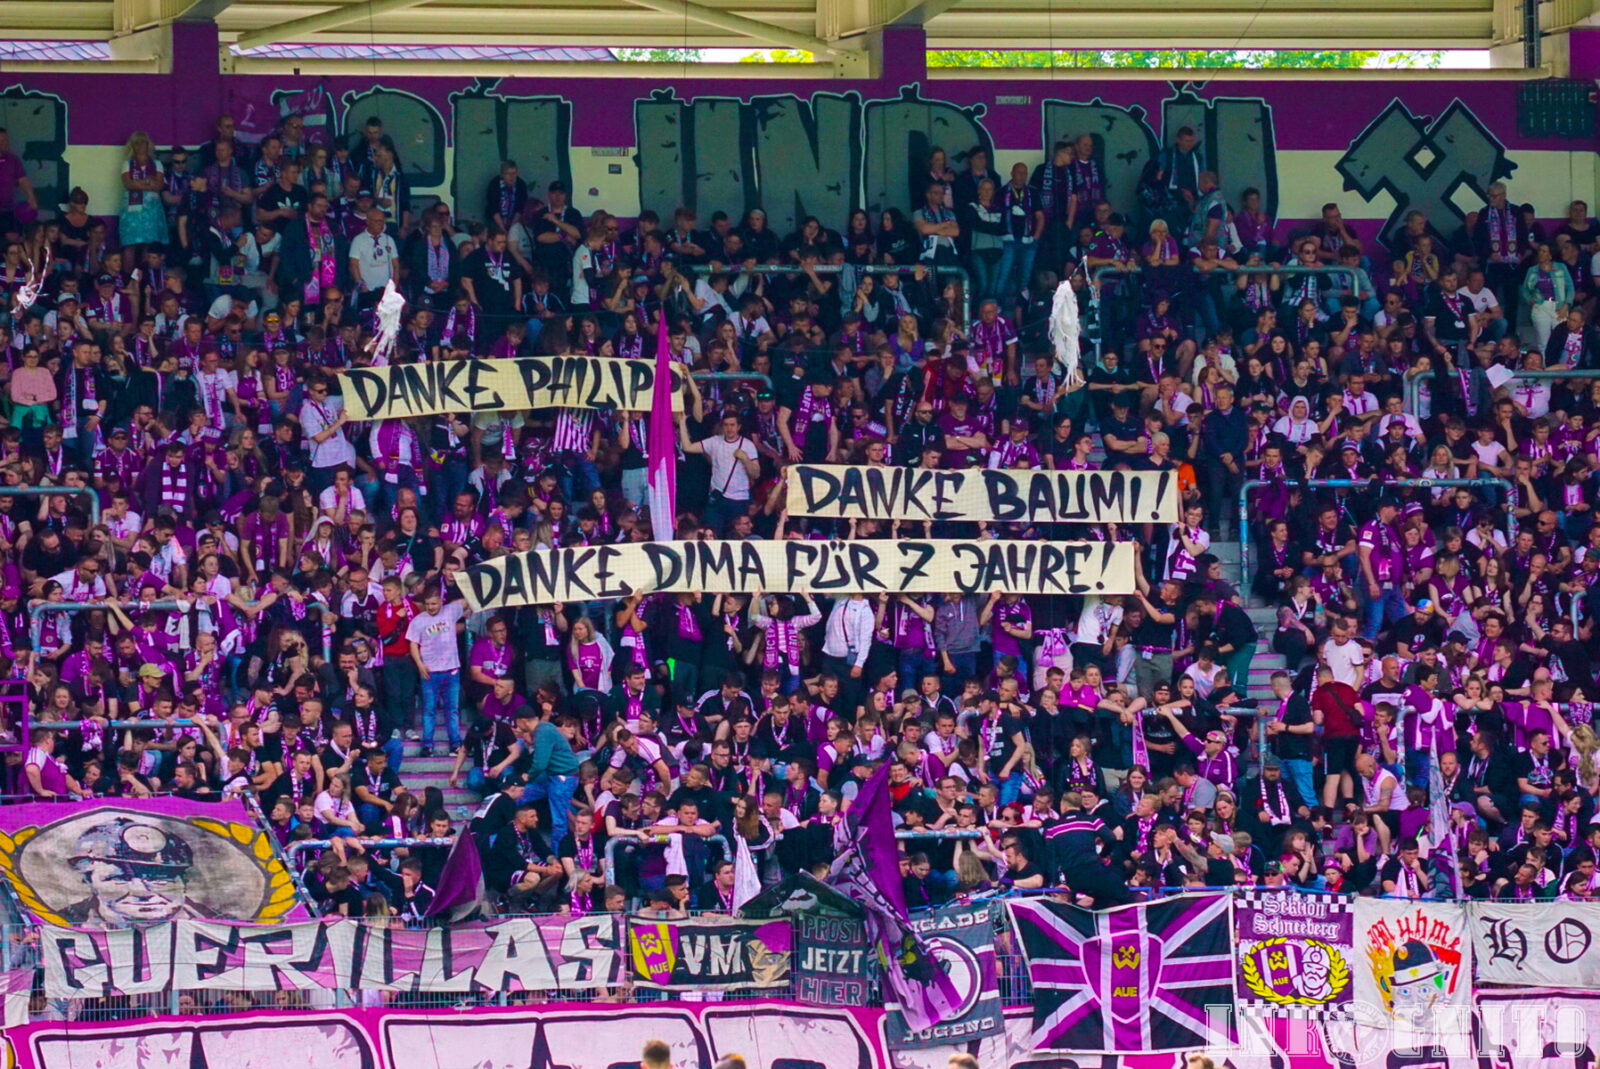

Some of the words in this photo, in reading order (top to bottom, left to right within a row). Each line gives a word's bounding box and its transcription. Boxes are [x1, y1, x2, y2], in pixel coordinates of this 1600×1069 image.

[344, 358, 505, 418] DANKE
[796, 465, 967, 519] DANKE
[464, 545, 633, 608] DANKE
[641, 540, 766, 592] DIMA
[786, 540, 888, 590] FÜR
[897, 541, 935, 588] 7
[953, 541, 1117, 594] JAHRE!
[1262, 893, 1328, 919] Sektion
[911, 909, 990, 934] IGADE
[1252, 912, 1341, 942] Schneeberg
[42, 914, 626, 999] GUERILLAS
[649, 962, 669, 974] AUE
[680, 933, 745, 976] VM
[801, 946, 864, 974] JETZT
[799, 976, 862, 1007] HIER
[1112, 986, 1138, 998] AUE
[1273, 976, 1289, 985] AUE
